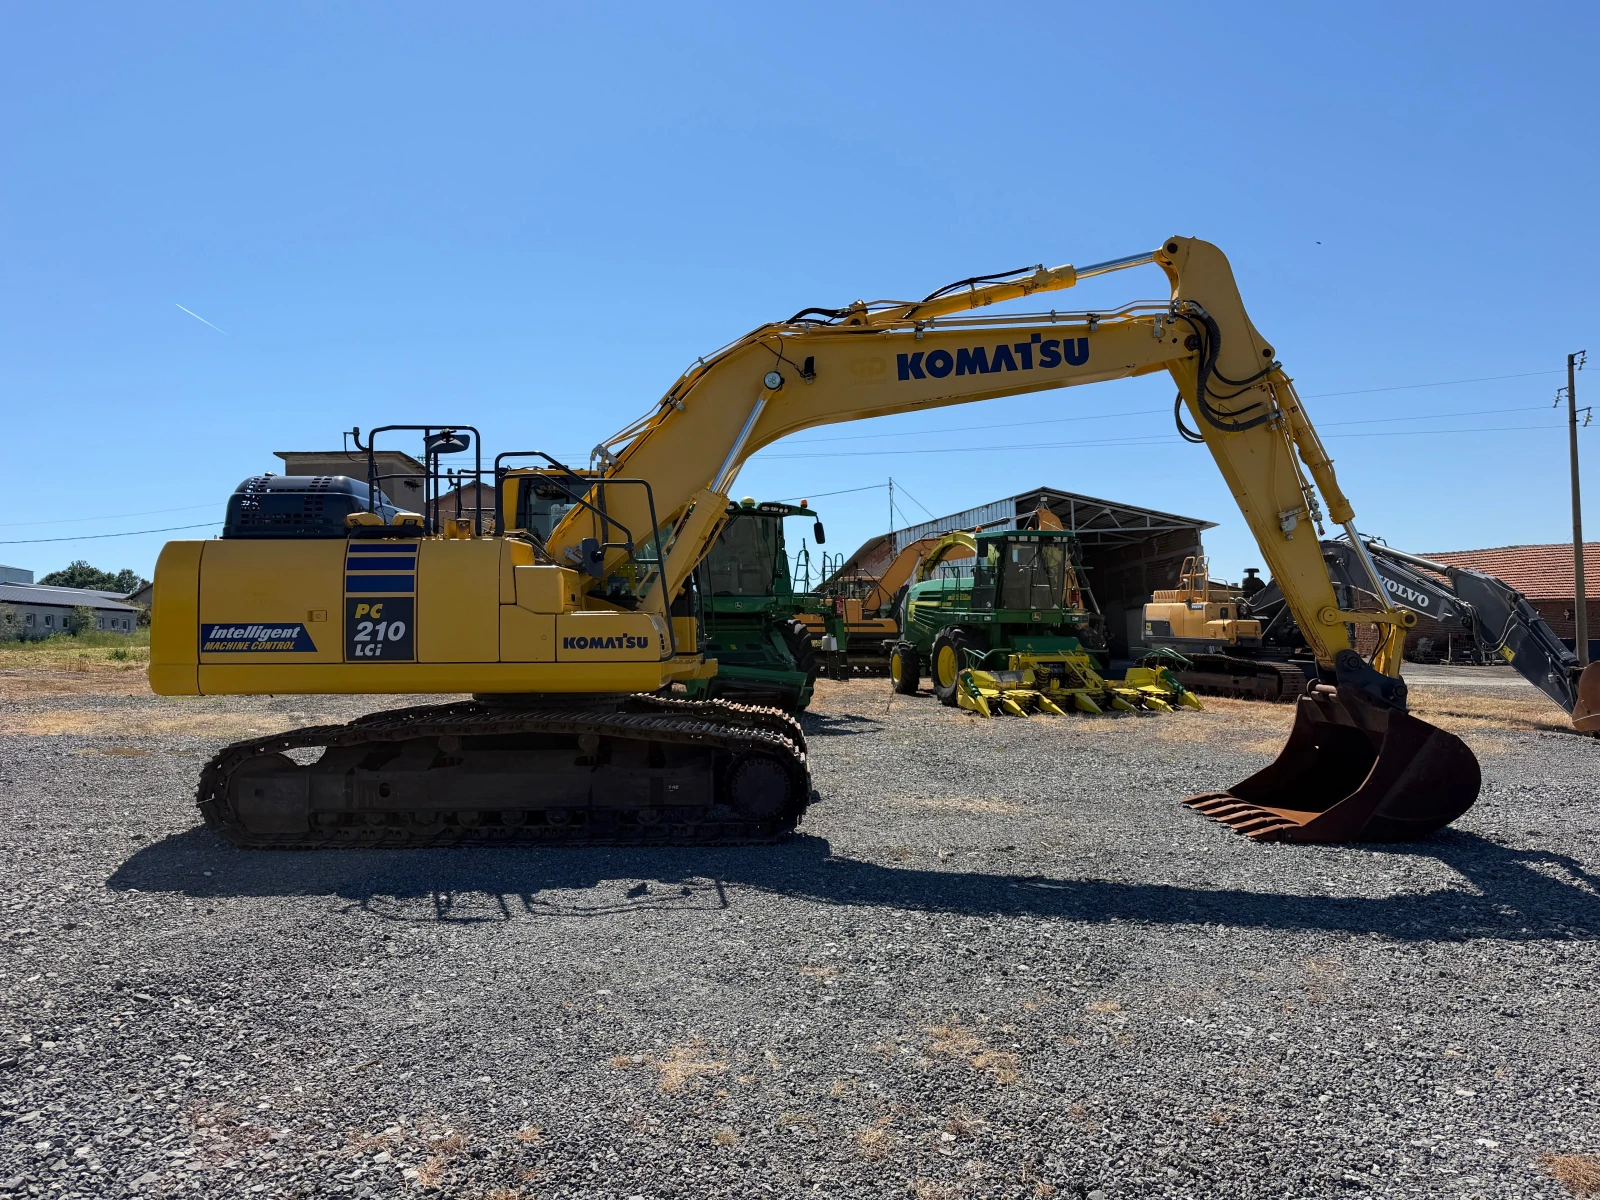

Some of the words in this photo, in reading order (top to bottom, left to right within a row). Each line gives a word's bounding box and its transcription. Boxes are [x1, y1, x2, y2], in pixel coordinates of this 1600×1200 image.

[897, 333, 1090, 381] KOMATSU
[355, 604, 383, 619] PC
[209, 626, 301, 642] intelligent
[353, 621, 406, 642] 210
[203, 641, 250, 651] MACHINE
[251, 641, 295, 650] CONTROL
[563, 633, 648, 650] KOMATSU
[355, 643, 383, 657] LCi
